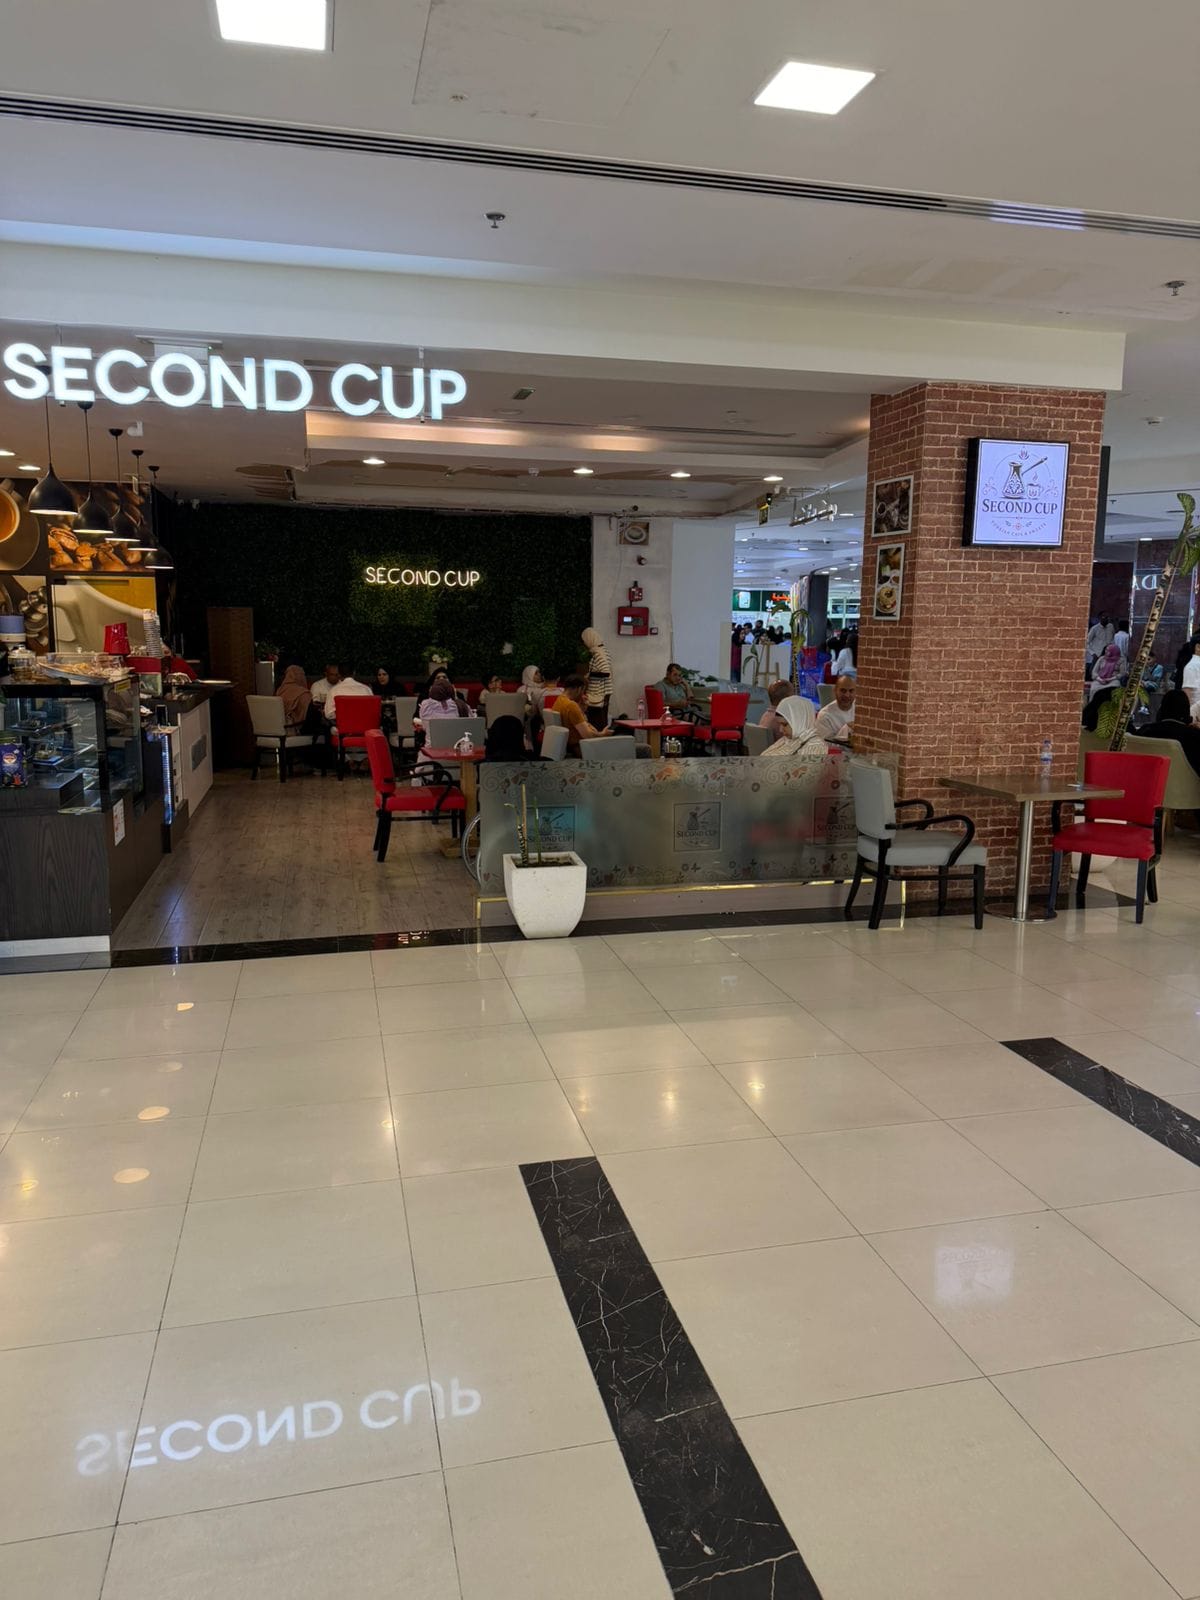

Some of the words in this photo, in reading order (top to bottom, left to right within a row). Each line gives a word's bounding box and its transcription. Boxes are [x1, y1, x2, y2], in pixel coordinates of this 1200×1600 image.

[3, 343, 313, 412] SECOND
[330, 363, 467, 420] CUP
[982, 499, 1032, 514] SECOND
[1035, 502, 1058, 514] CUP
[366, 566, 441, 586] SECOND
[444, 570, 480, 587] CUP
